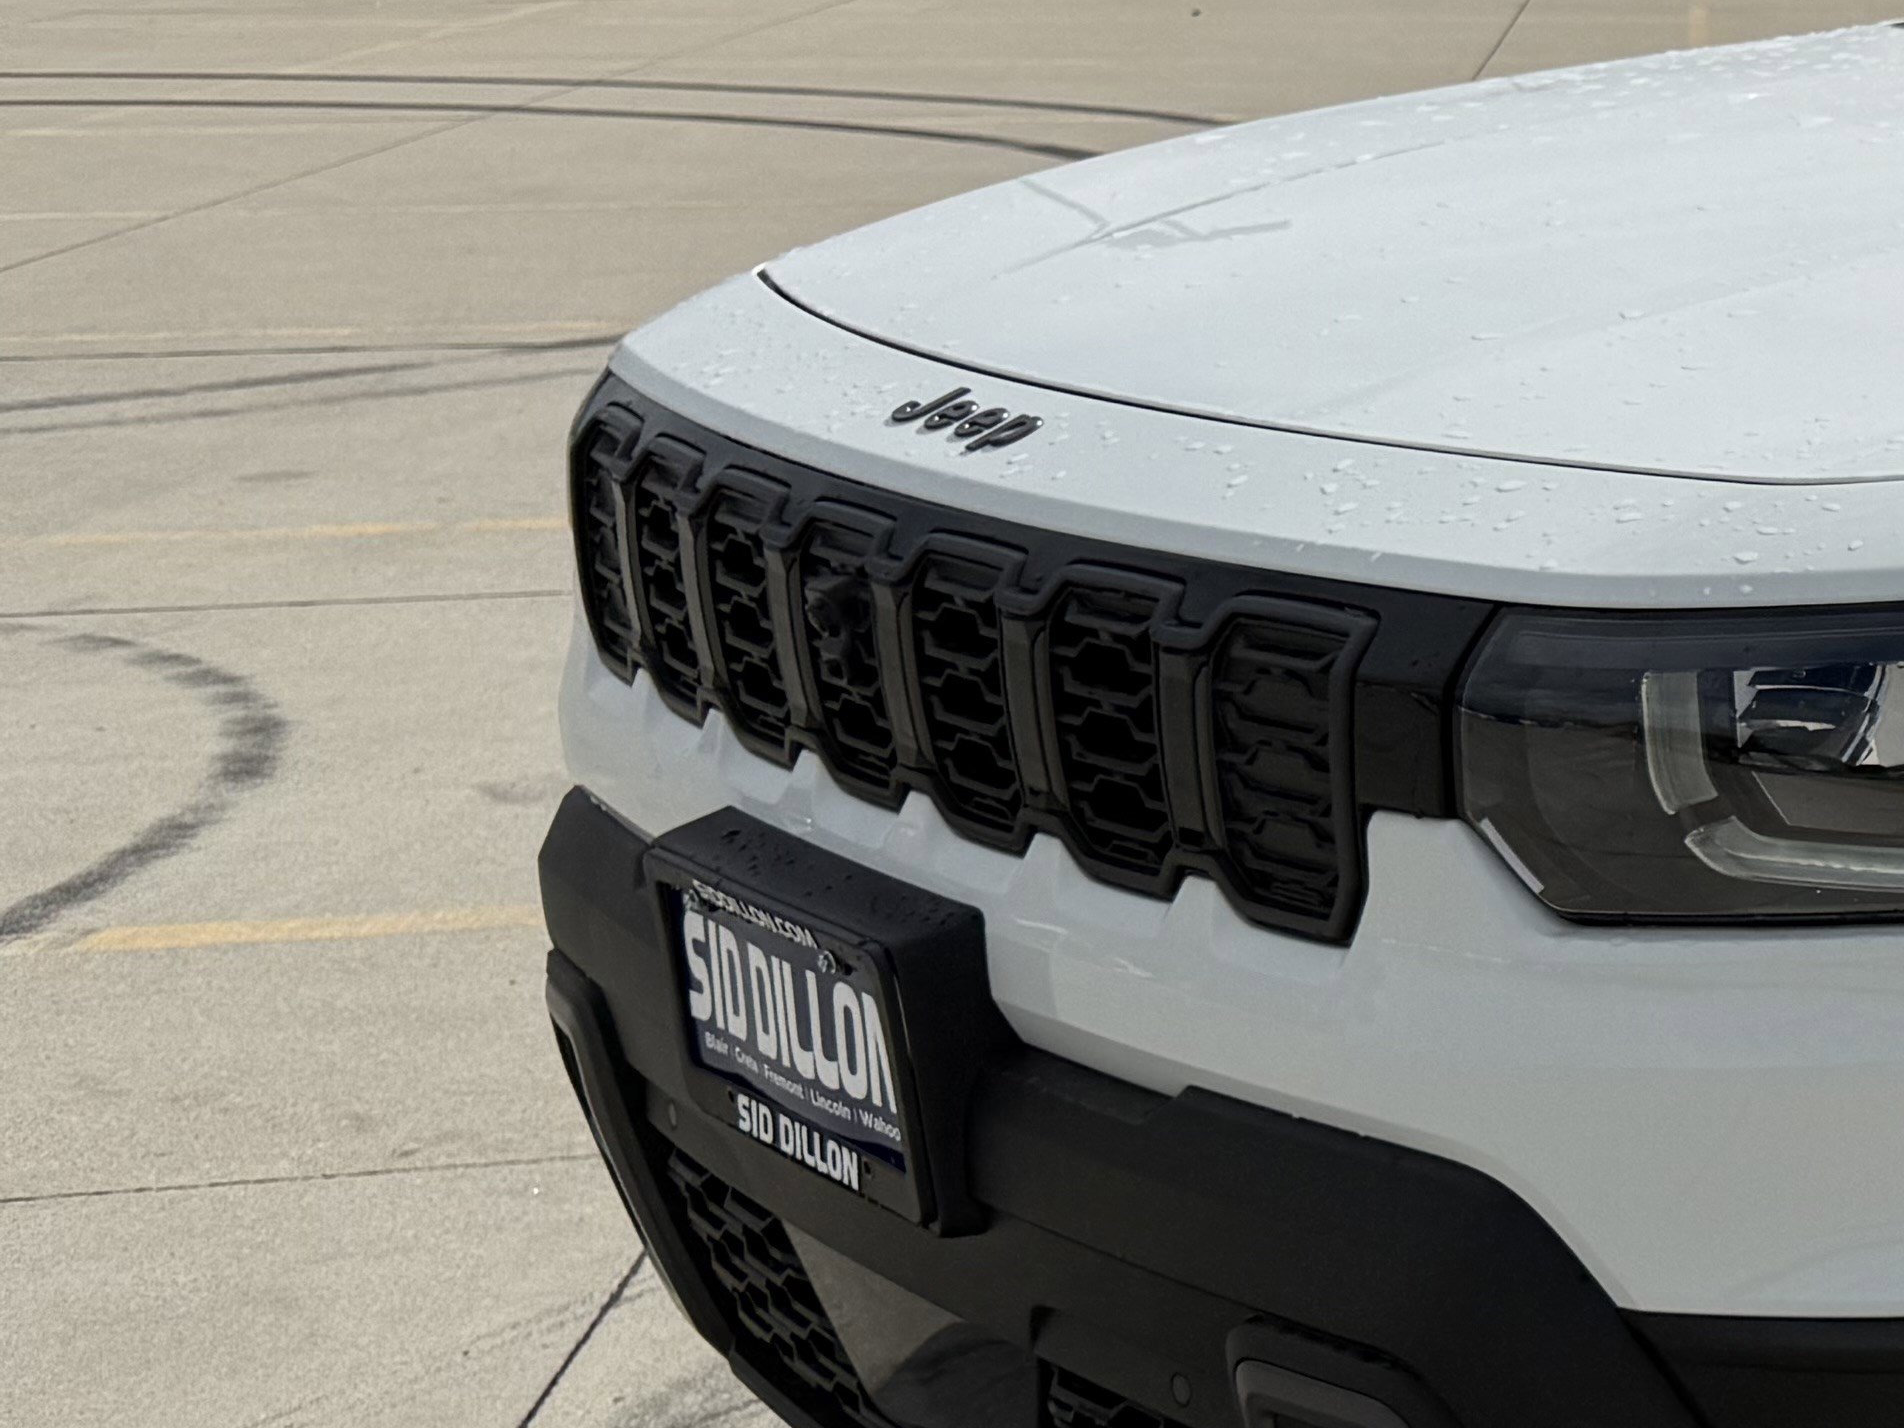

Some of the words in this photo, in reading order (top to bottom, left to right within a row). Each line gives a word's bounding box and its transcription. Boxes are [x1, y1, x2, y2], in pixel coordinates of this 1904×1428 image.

[890, 386, 1045, 452] Jeep
[683, 910, 749, 1043] SID
[737, 1093, 773, 1145] SID
[778, 1112, 859, 1191] DILLON
[809, 1088, 852, 1121] Lincoln
